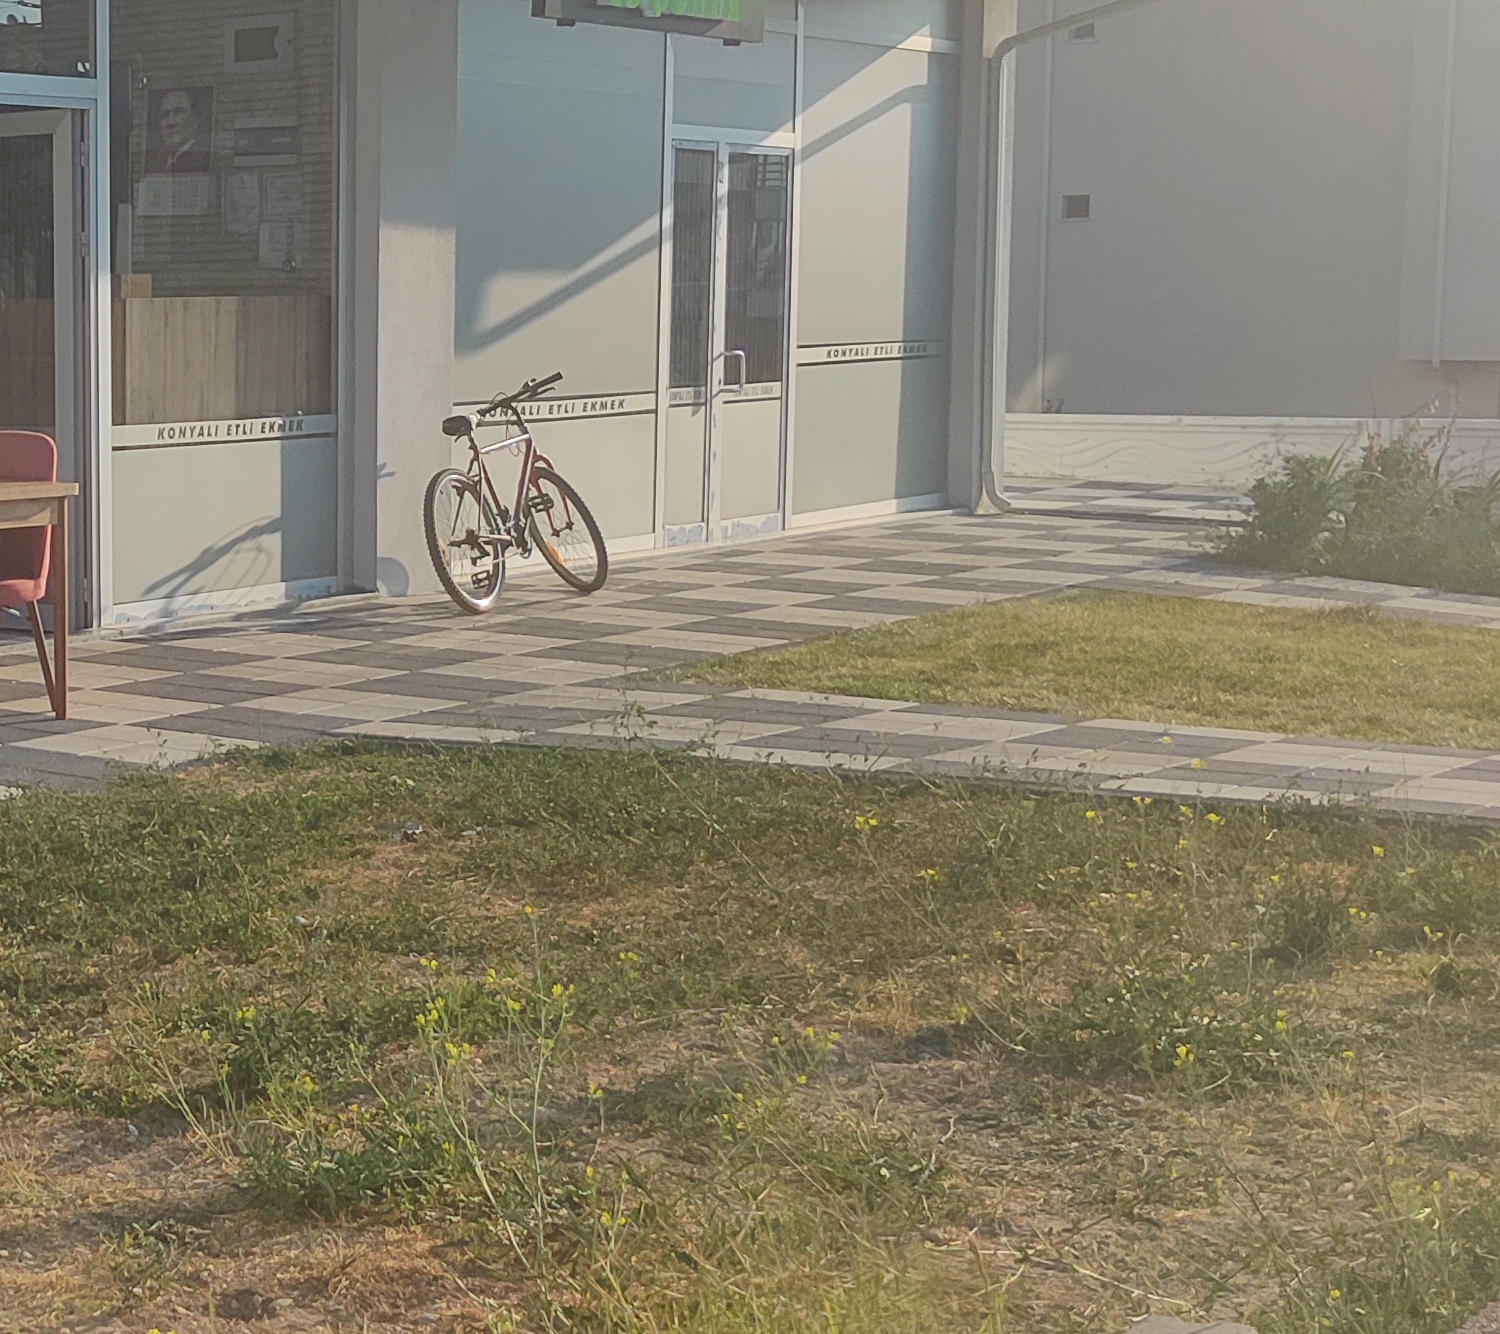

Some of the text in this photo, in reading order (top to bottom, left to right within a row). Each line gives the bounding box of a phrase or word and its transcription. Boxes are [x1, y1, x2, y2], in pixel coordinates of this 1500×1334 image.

[826, 347, 869, 359] KONYALI
[582, 398, 627, 413] EKMEK
[158, 425, 219, 440] KONYALI
[261, 419, 304, 434] EKMEK
